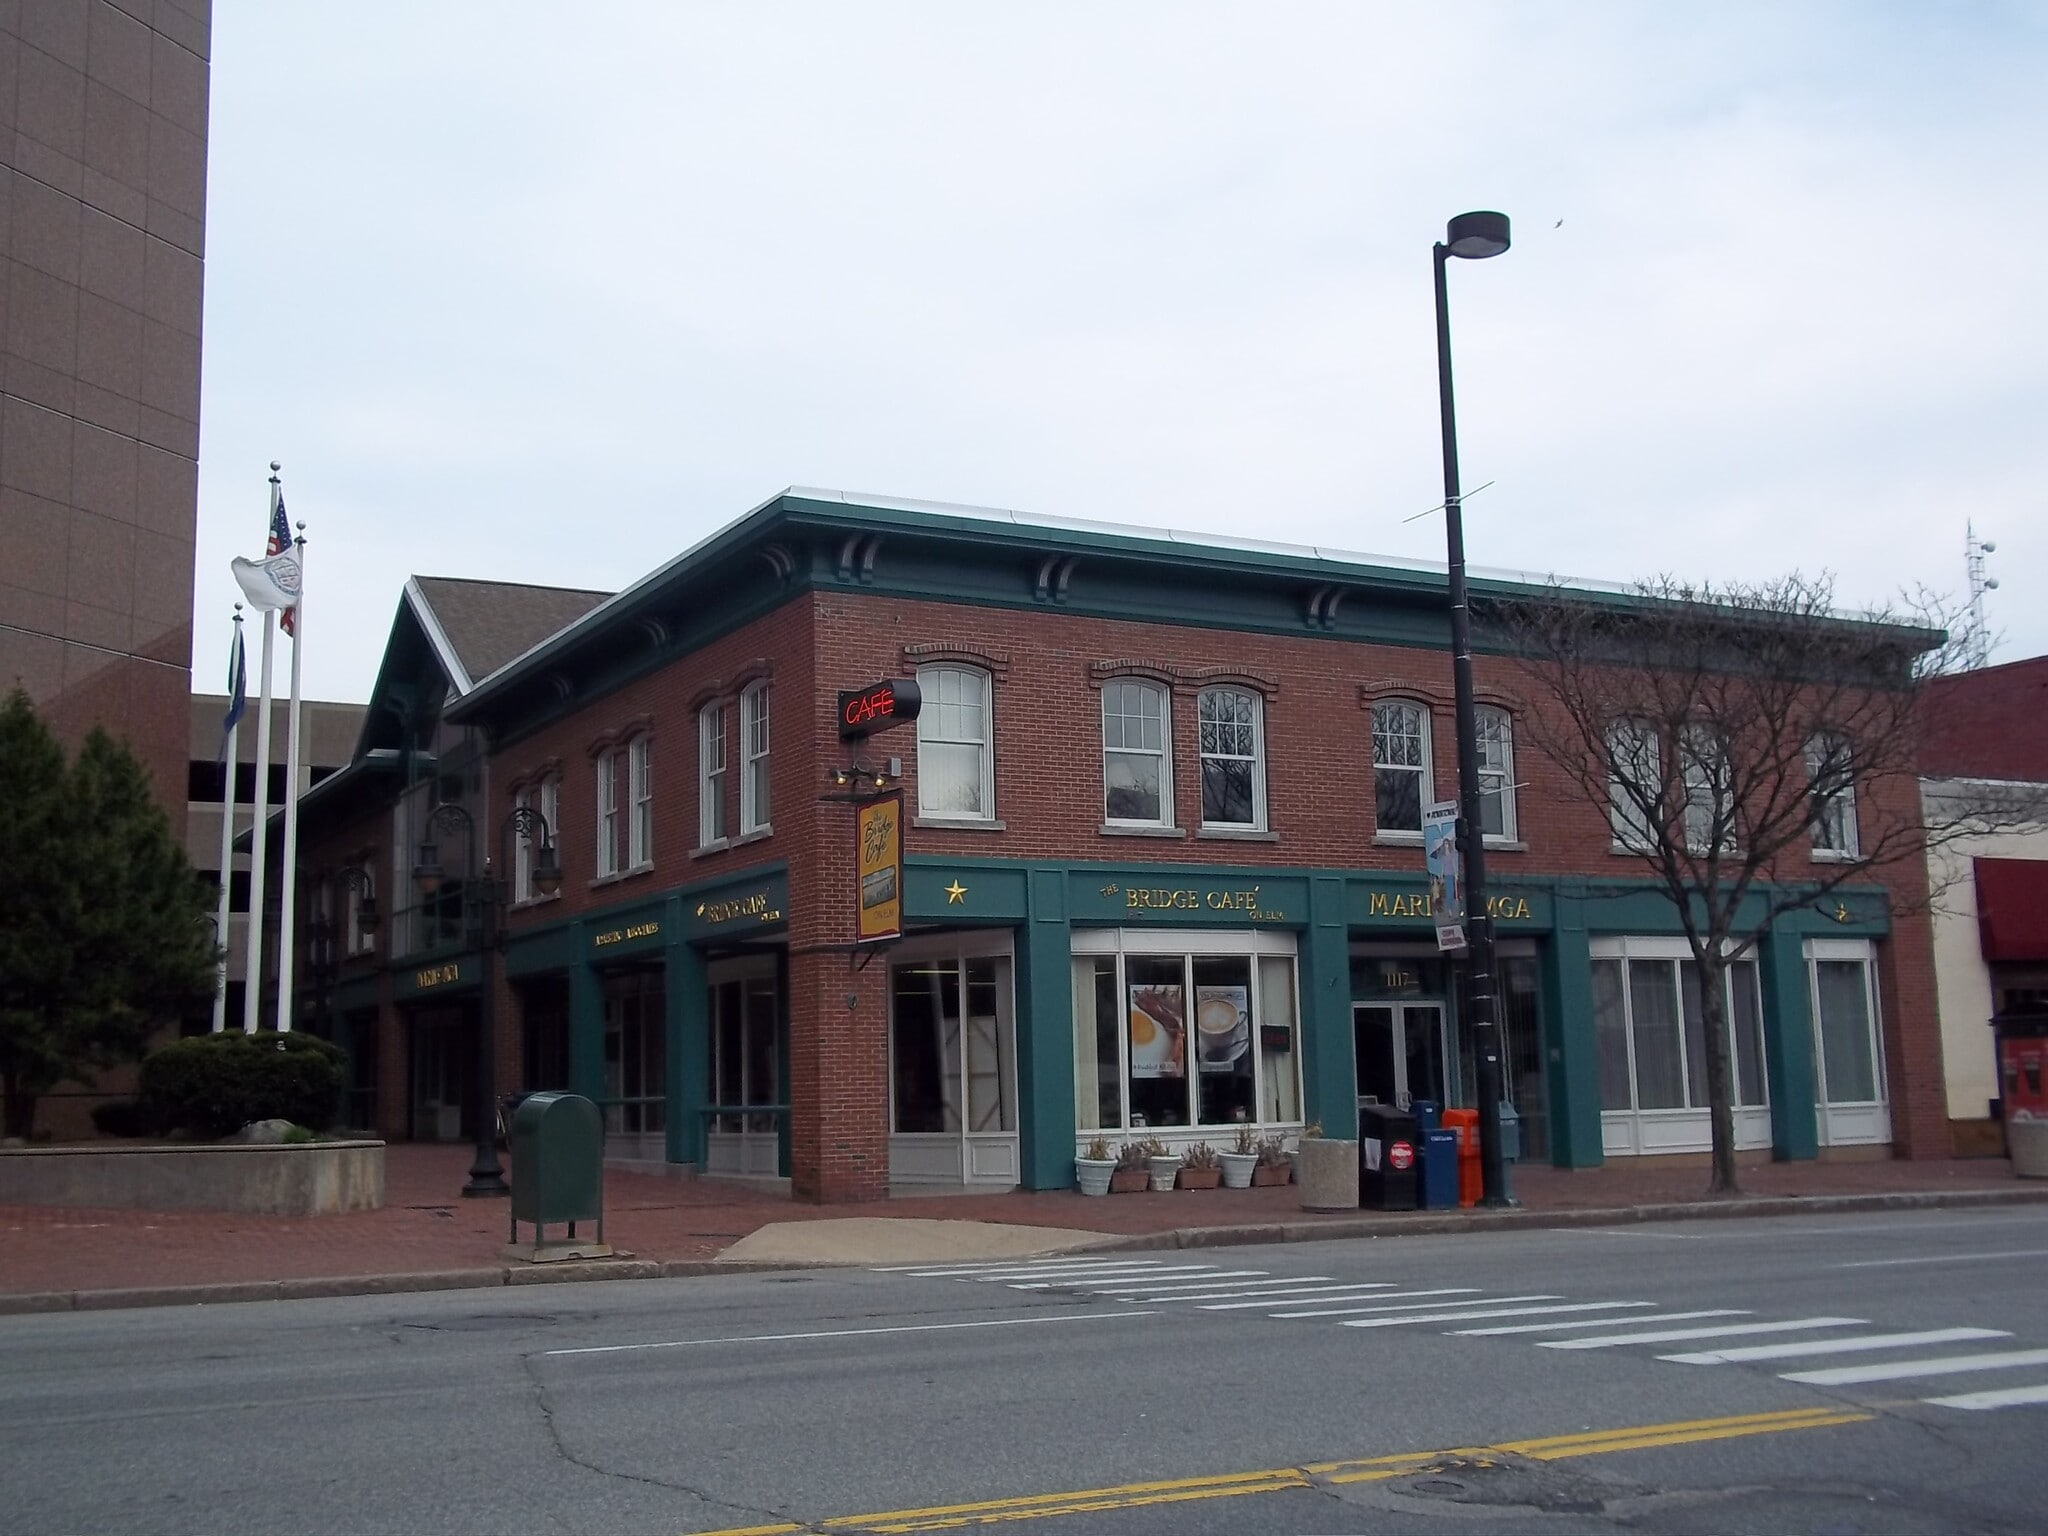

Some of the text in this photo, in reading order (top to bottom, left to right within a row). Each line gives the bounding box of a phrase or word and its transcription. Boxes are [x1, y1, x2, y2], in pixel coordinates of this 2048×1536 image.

[1100, 883, 1119, 897] THE
[1126, 889, 1199, 908] BRIDGE
[1369, 894, 1432, 917] MARI
[1249, 911, 1284, 920] ON ELM
[1387, 972, 1409, 987] 1117
